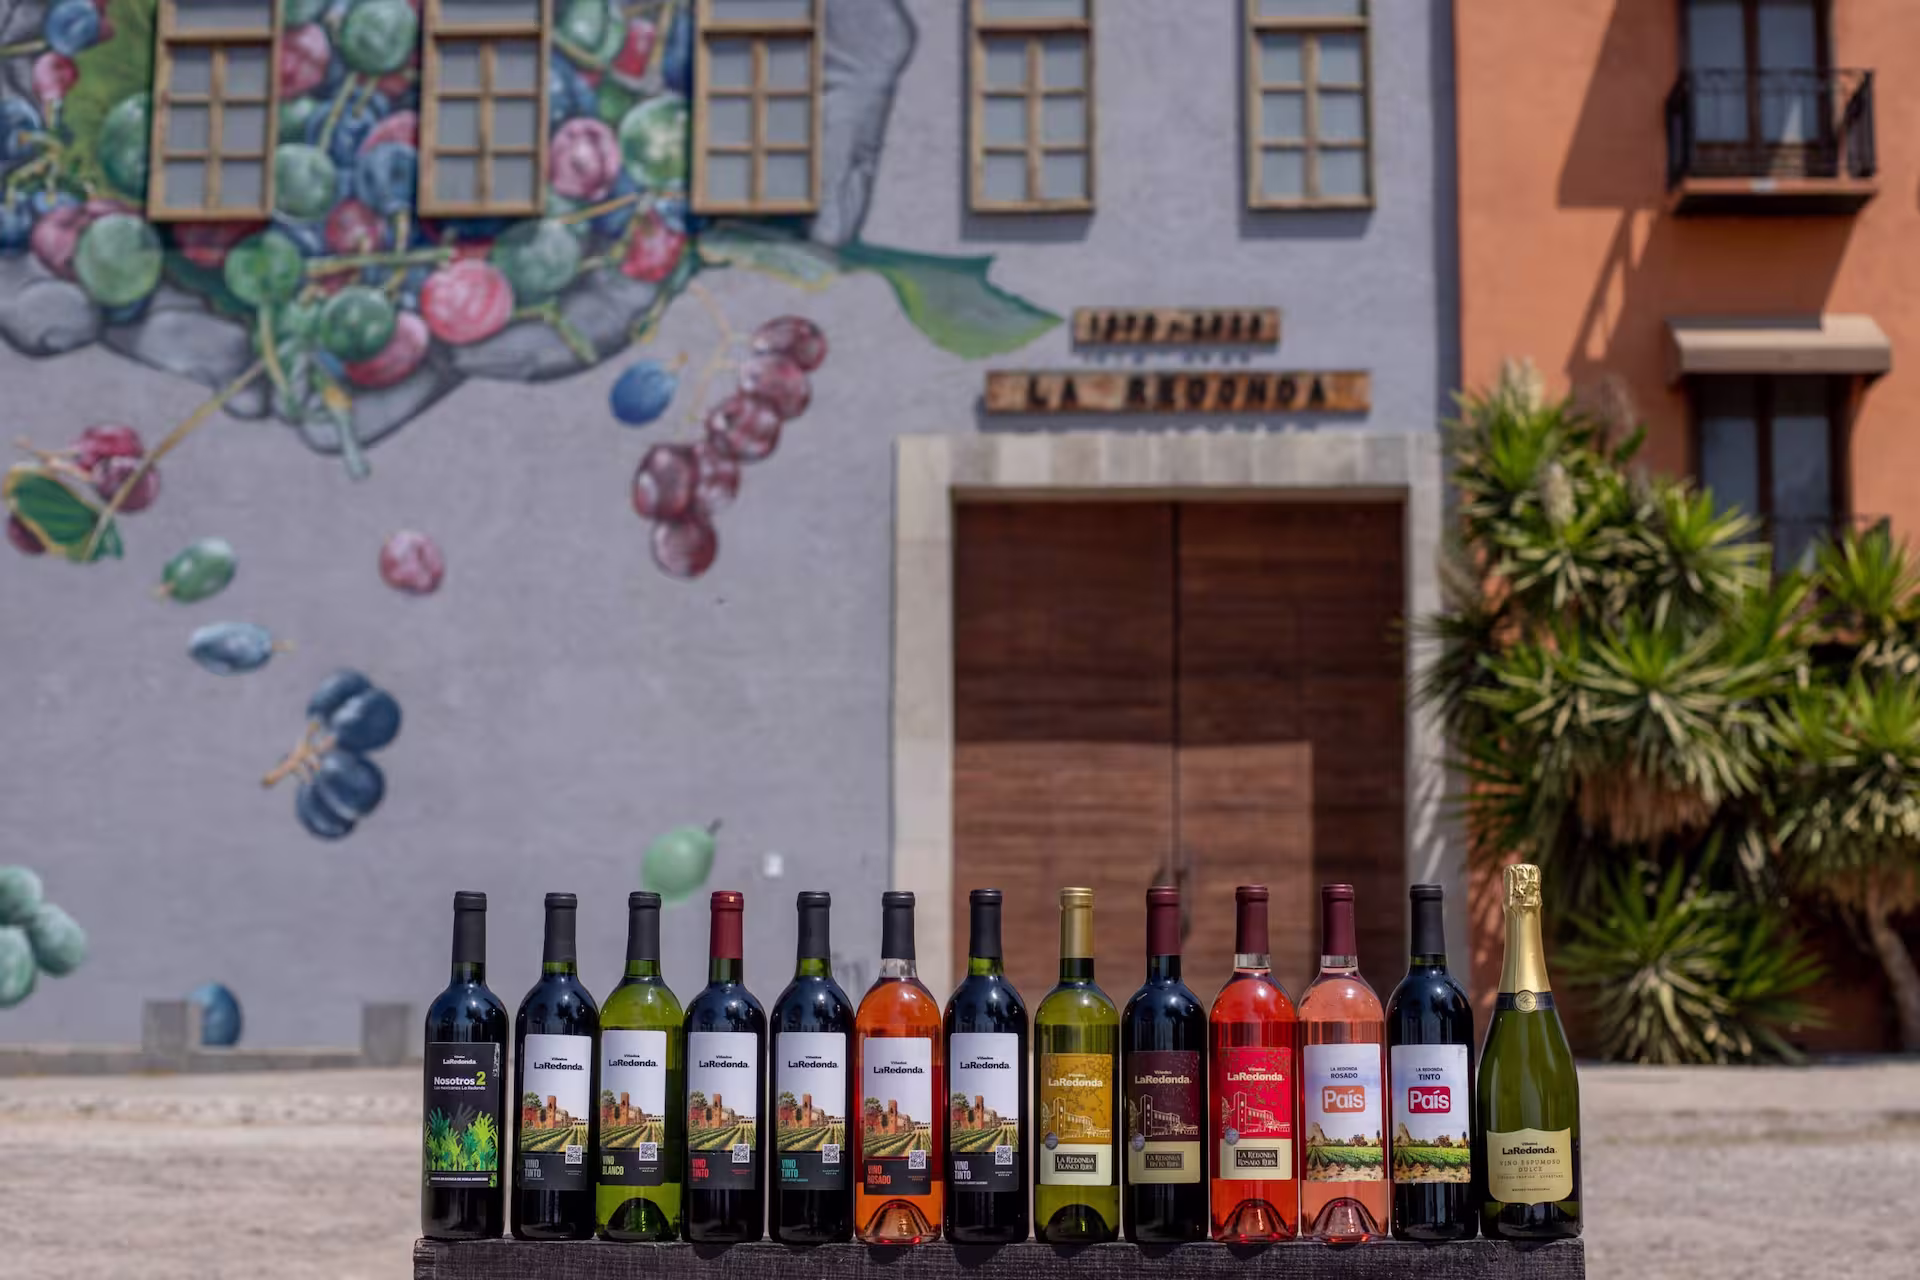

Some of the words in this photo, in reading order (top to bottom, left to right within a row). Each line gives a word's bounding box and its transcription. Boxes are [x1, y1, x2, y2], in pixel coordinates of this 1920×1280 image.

[1028, 375, 1079, 408] LA
[434, 1077, 475, 1085] Nosotros
[476, 1071, 486, 1085] 2
[1418, 1073, 1441, 1081] TINTO
[1324, 1089, 1364, 1109] País
[1409, 1089, 1450, 1109] País
[525, 1159, 539, 1168] VINO
[602, 1156, 615, 1164] VINO
[692, 1159, 706, 1168] VINO
[781, 1159, 796, 1168] VINO
[868, 1165, 882, 1174] VINO
[954, 1161, 968, 1170] VINO
[525, 1169, 541, 1178] TINTO
[602, 1166, 624, 1175] BLANCO
[692, 1169, 709, 1178] TINTO
[781, 1169, 798, 1178] TINTO
[867, 1175, 891, 1184] ROSADO
[954, 1171, 971, 1180] TINTO
